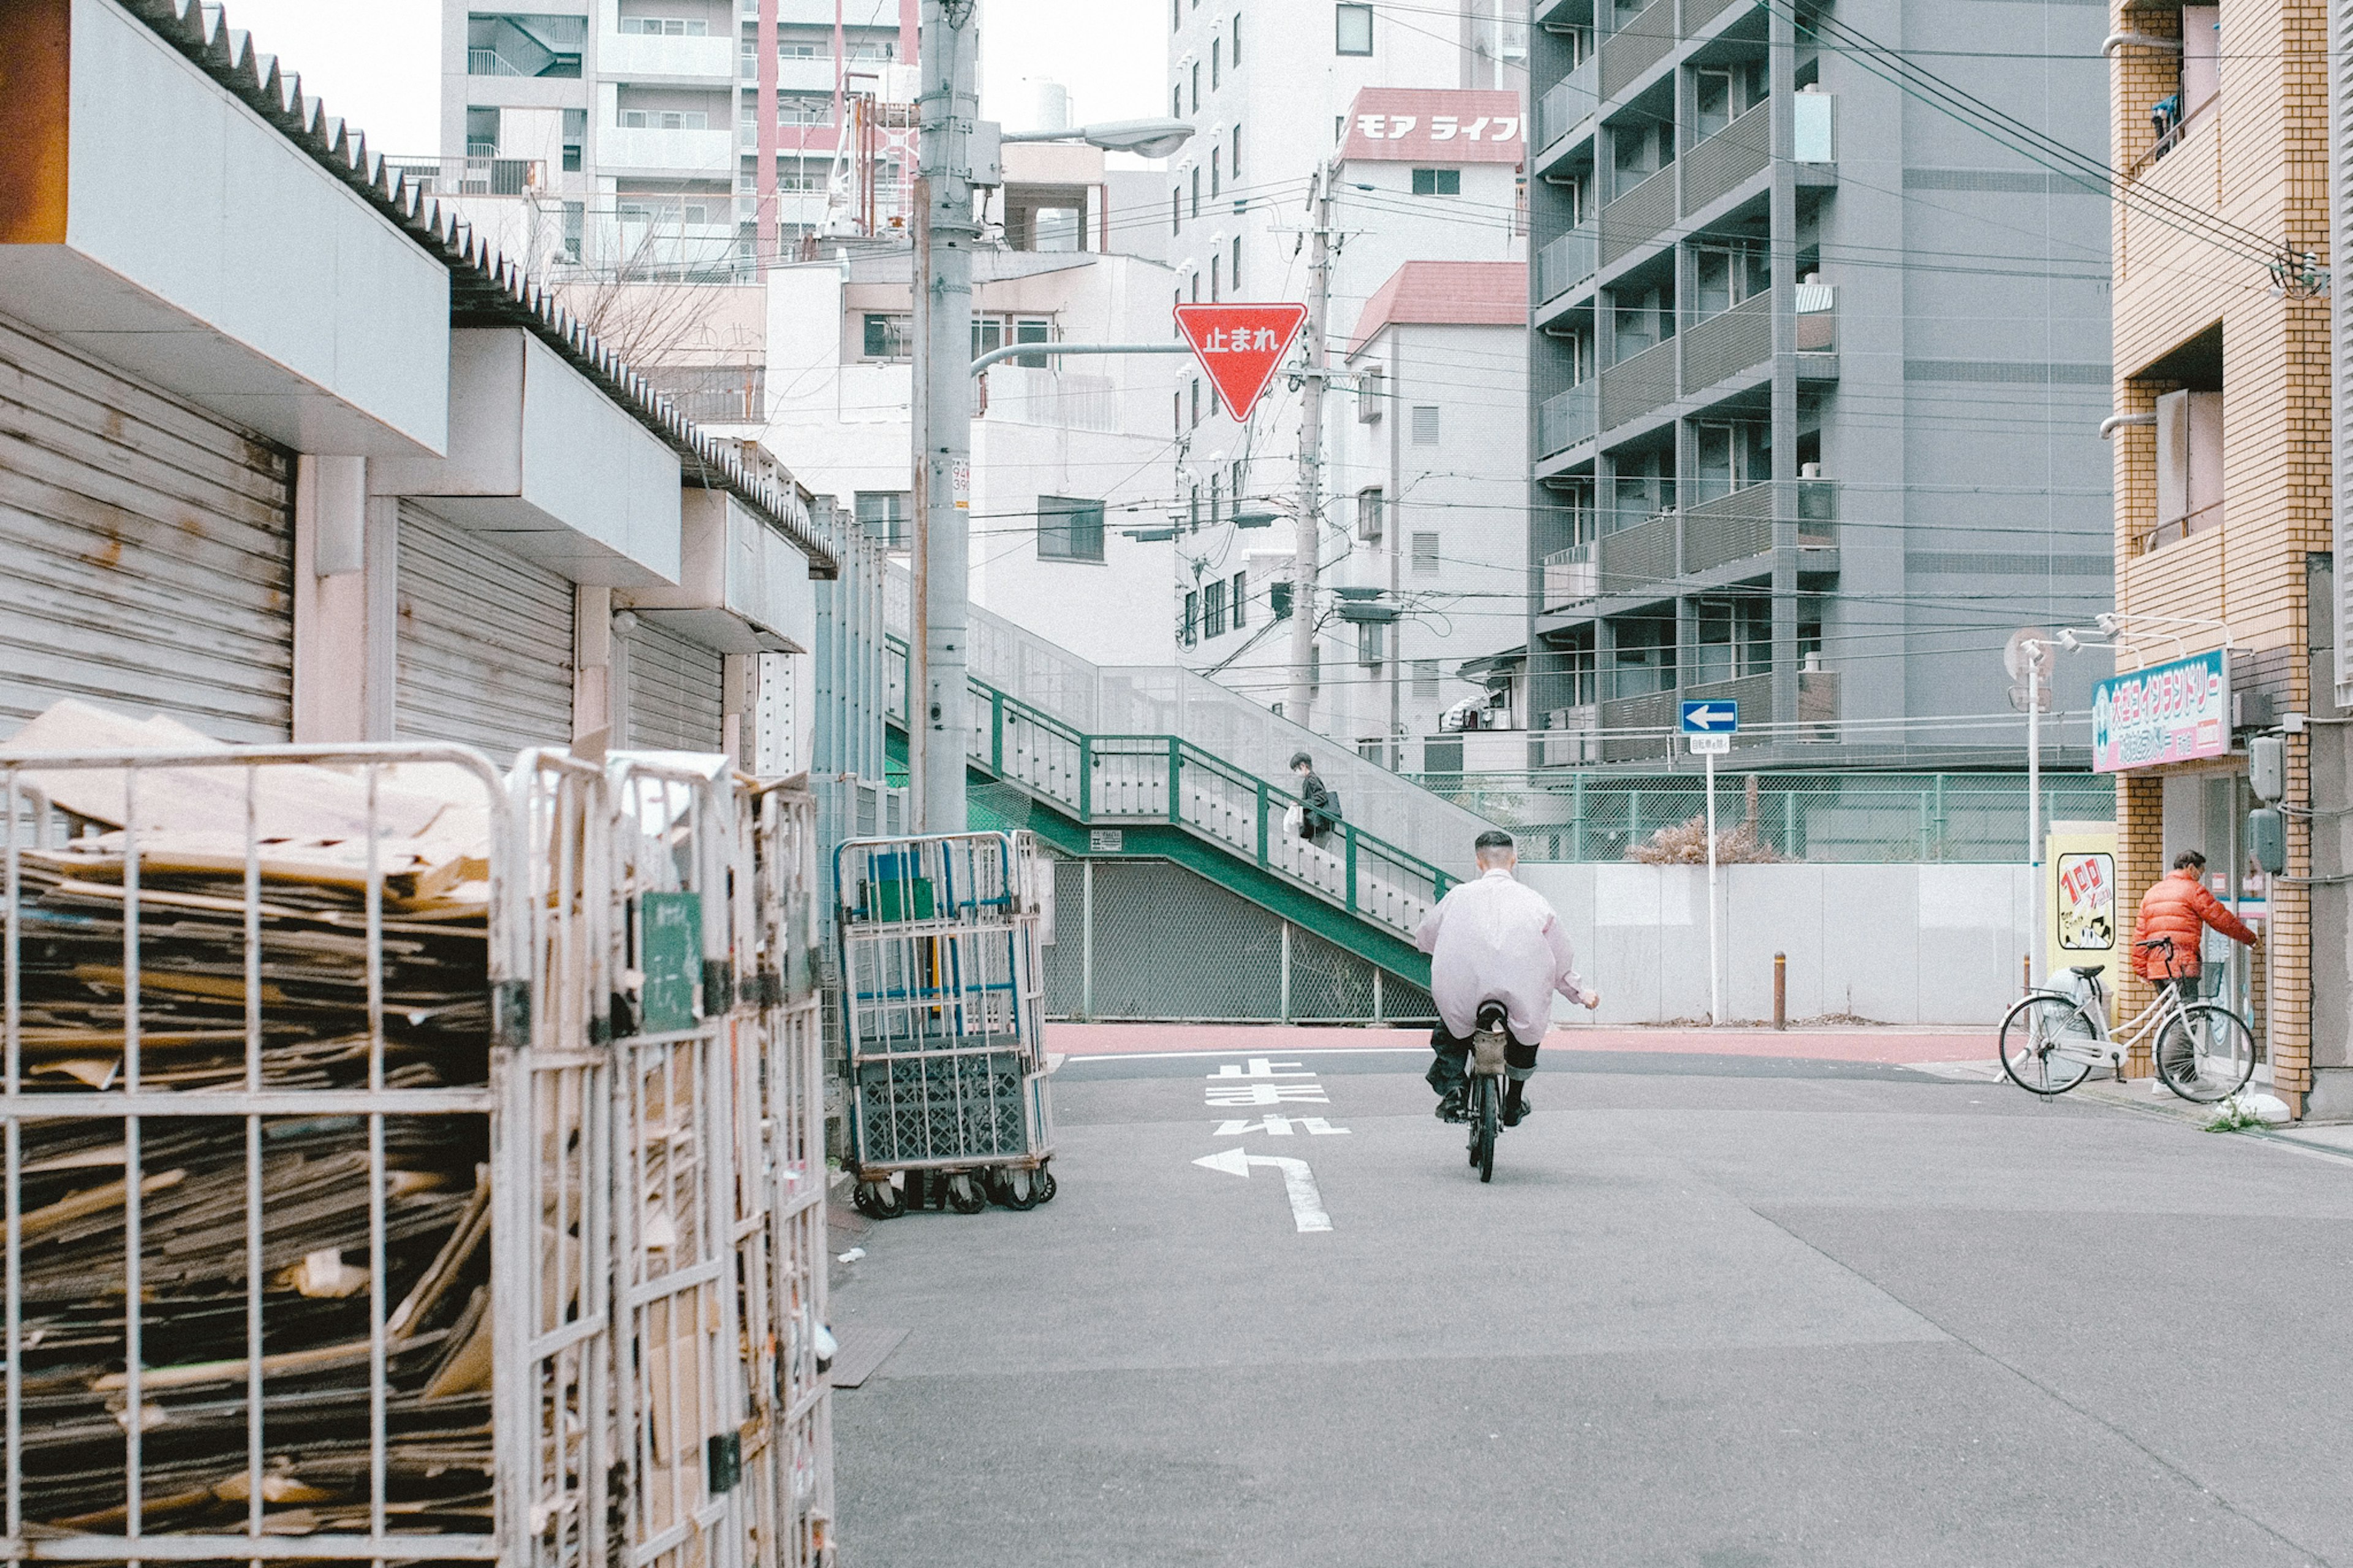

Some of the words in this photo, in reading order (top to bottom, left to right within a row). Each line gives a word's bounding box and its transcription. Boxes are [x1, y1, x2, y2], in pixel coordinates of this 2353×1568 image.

[1357, 114, 1417, 140] モア
[1431, 115, 1519, 141] ライフ
[1203, 327, 1279, 352] 止まれ
[2112, 661, 2219, 730] 大型コインランドリー
[2061, 858, 2102, 906] 100
[1205, 1058, 1352, 1135] 止まれ
